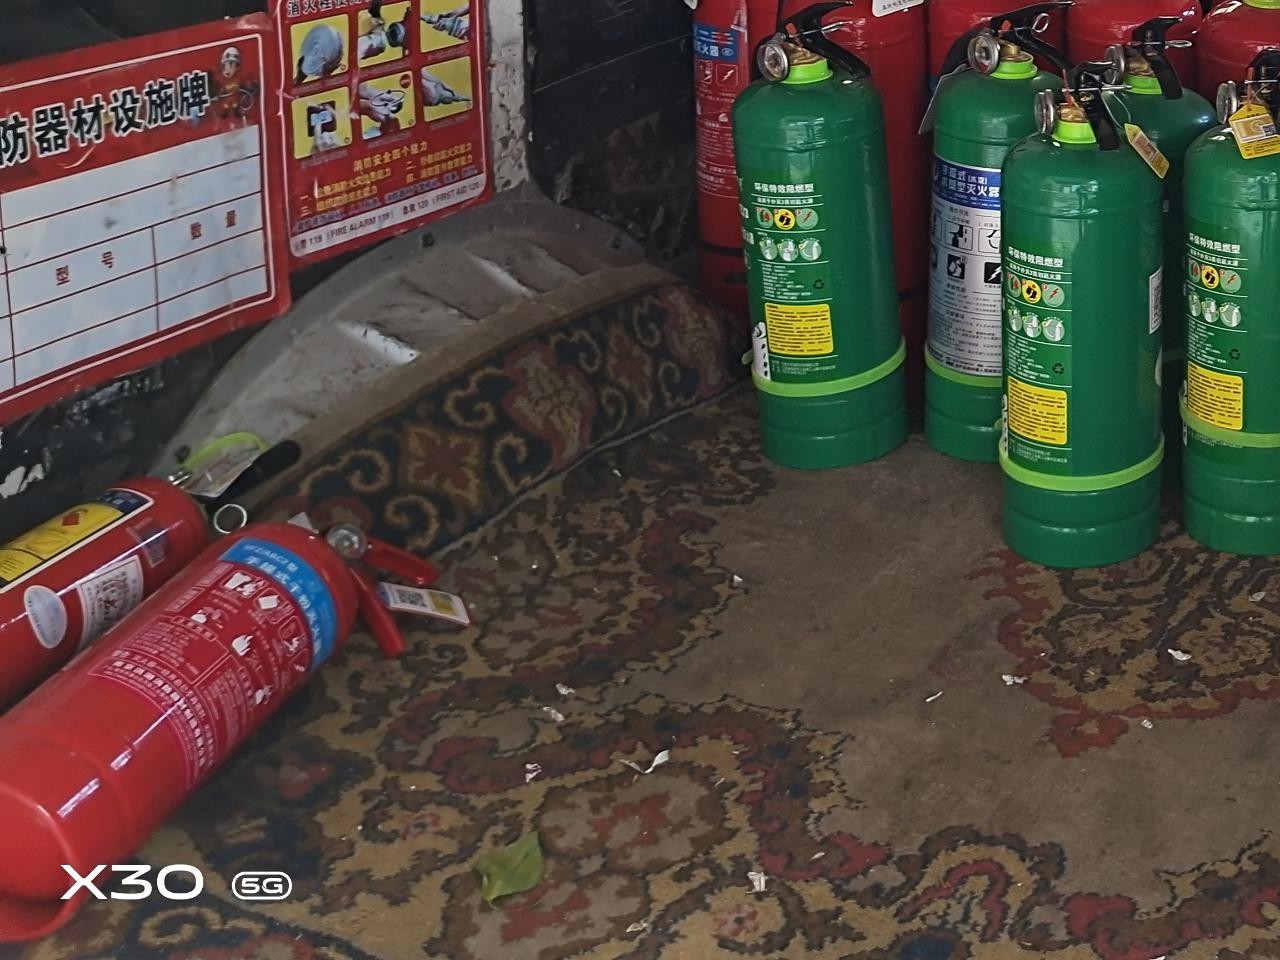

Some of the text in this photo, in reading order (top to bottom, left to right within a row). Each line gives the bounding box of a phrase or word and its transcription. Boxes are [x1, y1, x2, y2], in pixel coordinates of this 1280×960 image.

[0, 71, 212, 169] 防器材设施牌
[754, 182, 814, 194] 环保特效阻燃型
[1188, 232, 1240, 254] 环保特效阻燃型
[1008, 246, 1064, 268] 环保特效阻燃型
[56, 265, 70, 286] 型
